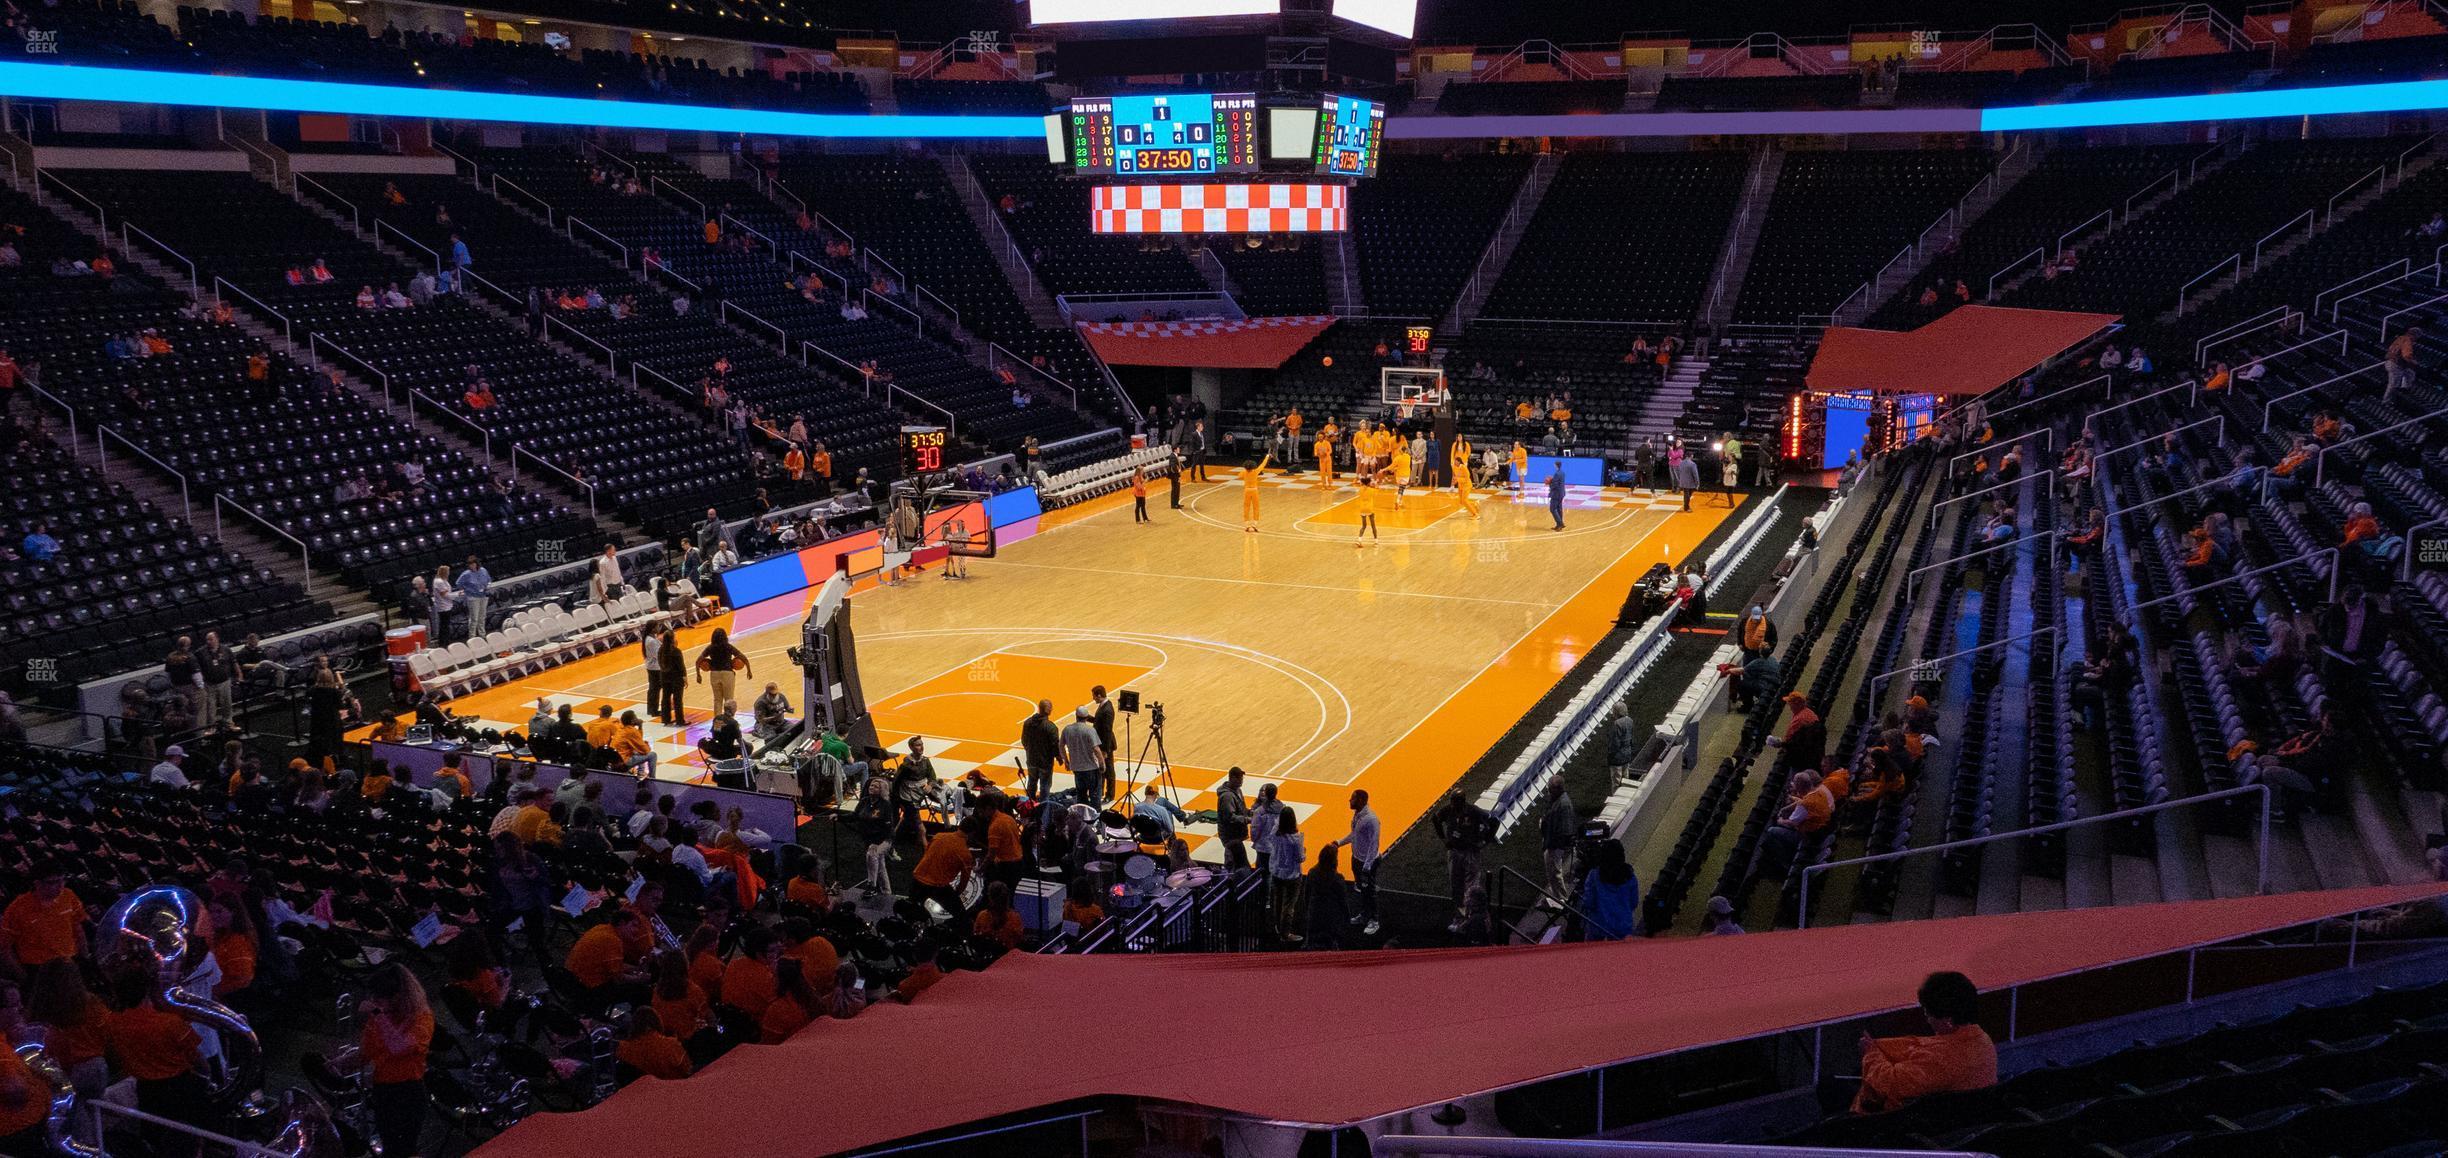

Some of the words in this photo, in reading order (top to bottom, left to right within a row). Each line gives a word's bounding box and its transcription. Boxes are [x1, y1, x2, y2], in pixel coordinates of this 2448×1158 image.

[1099, 104, 1111, 112] PTS
[1242, 100, 1255, 108] PTS
[1160, 108, 1165, 120] 1
[1217, 113, 1223, 121] 3
[1232, 112, 1238, 120] 0
[1245, 112, 1251, 120] 0
[1352, 111, 1356, 123] 1
[1074, 116, 1085, 125] 00
[1090, 116, 1094, 124] 1
[1103, 116, 1109, 124] 9
[1102, 127, 1112, 135] 17
[1233, 123, 1239, 131] 0
[1245, 123, 1252, 131] 7
[1124, 128, 1132, 142] 0
[1174, 133, 1181, 143] 4
[1194, 127, 1203, 140] 0
[1233, 134, 1239, 142] 2
[1246, 134, 1252, 142] 7
[1076, 138, 1086, 146] 13
[1146, 134, 1152, 143] 4
[1103, 148, 1114, 156] 10
[1246, 145, 1253, 153] 2
[1106, 158, 1112, 166] 0
[1138, 150, 1191, 168] 37:50
[1200, 159, 1207, 168] 0
[1234, 156, 1240, 164] 0
[1247, 156, 1254, 164] 0
[1339, 152, 1358, 169] 37:50
[1123, 160, 1130, 170] 0
[1408, 330, 1428, 338] 37:50
[1411, 338, 1425, 351] 30
[912, 432, 944, 448] 37:50
[917, 446, 939, 470] 30
